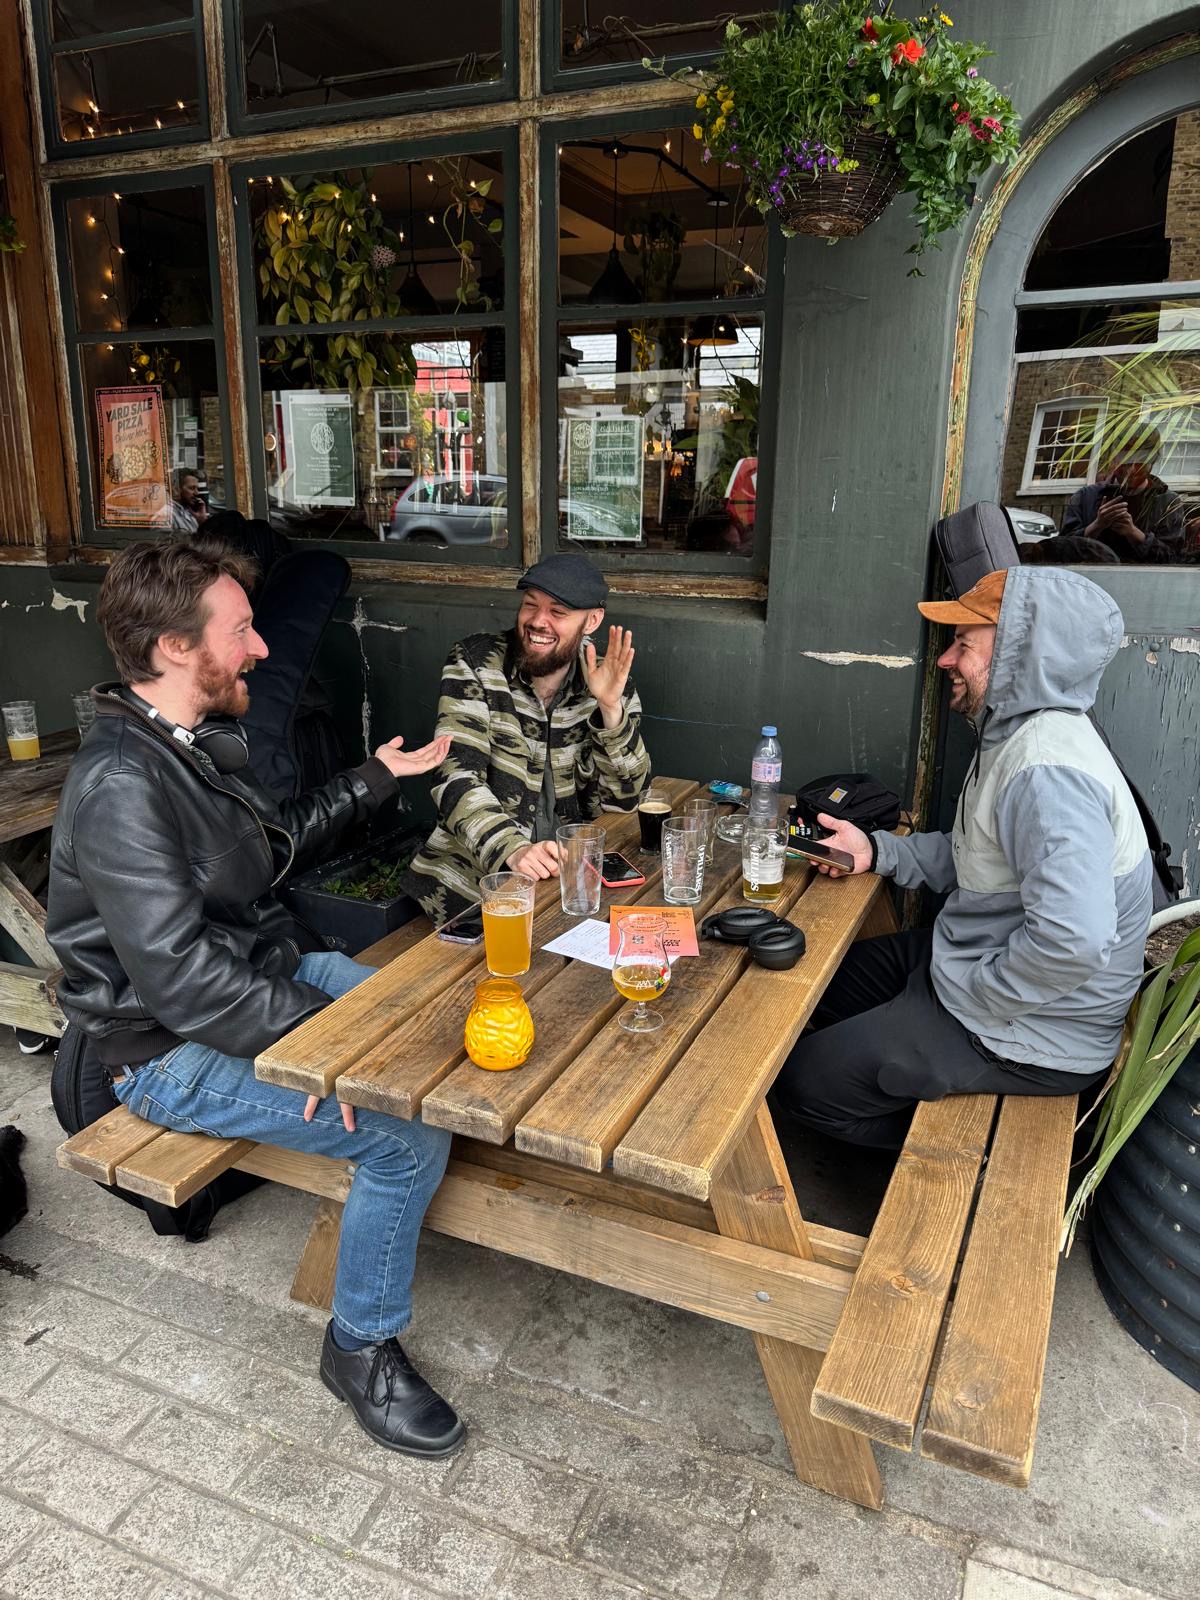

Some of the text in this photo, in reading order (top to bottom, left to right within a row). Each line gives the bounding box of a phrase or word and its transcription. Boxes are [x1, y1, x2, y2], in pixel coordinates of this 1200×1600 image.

[106, 397, 153, 423] YARD SALE
[117, 415, 143, 433] PIZZA
[695, 851, 705, 892] PILLARS
[750, 851, 760, 892] PILLARS
